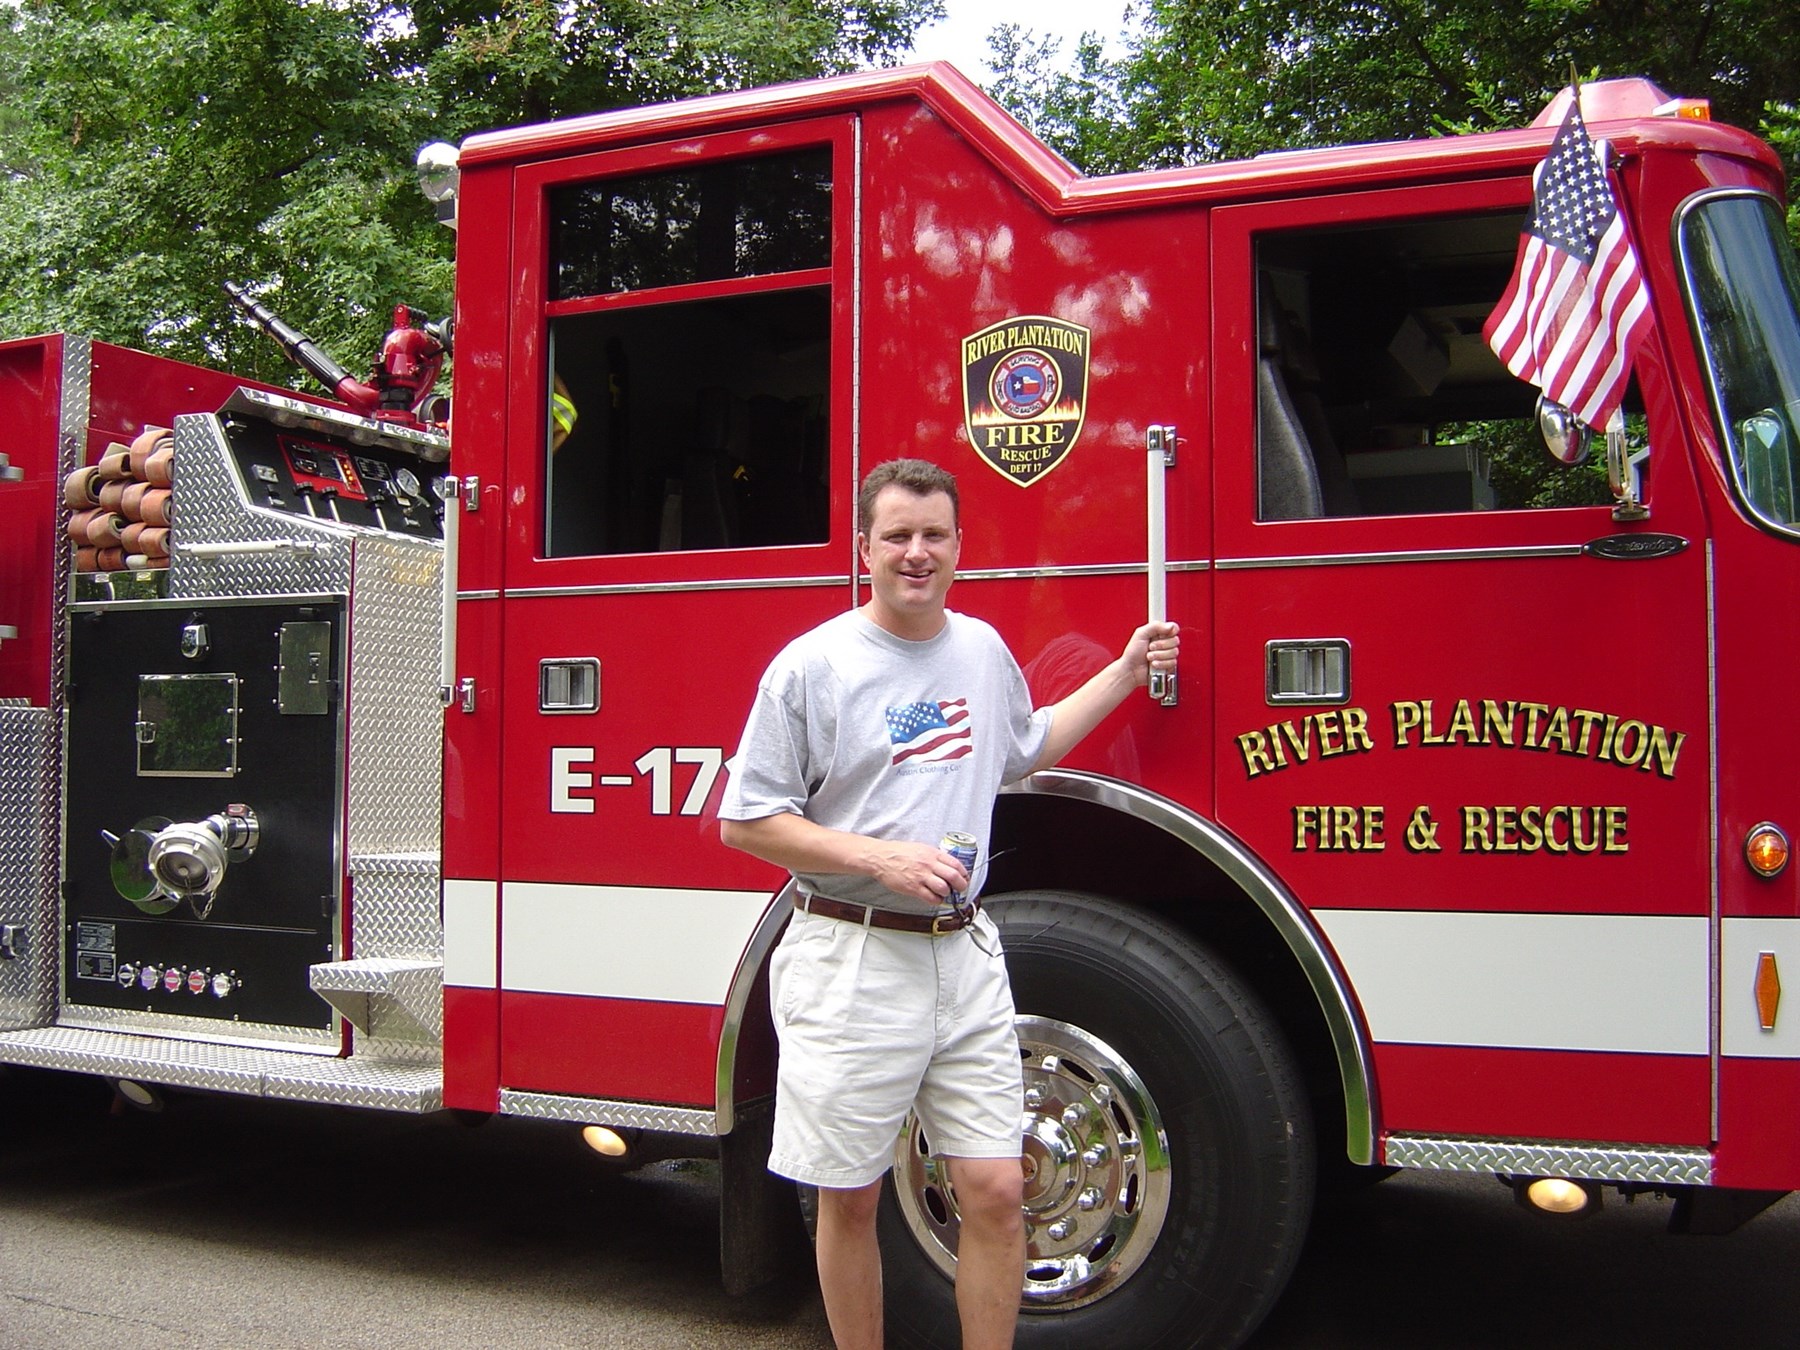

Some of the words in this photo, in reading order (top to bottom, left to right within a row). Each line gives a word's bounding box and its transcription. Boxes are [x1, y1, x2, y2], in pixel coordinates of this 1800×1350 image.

[967, 330, 1006, 365] RIVER
[1008, 325, 1084, 357] PLANTATION
[986, 422, 1065, 448] FIRE
[1000, 445, 1052, 462] RESCUE
[1010, 464, 1031, 474] DEPT
[1033, 463, 1042, 472] 17
[1236, 706, 1375, 779] RIVER
[1392, 699, 1687, 779] PLANTATION
[551, 747, 735, 815] E-17
[1292, 805, 1386, 853] FIRE
[1405, 804, 1442, 854] &
[1461, 805, 1630, 853] RESCUE
